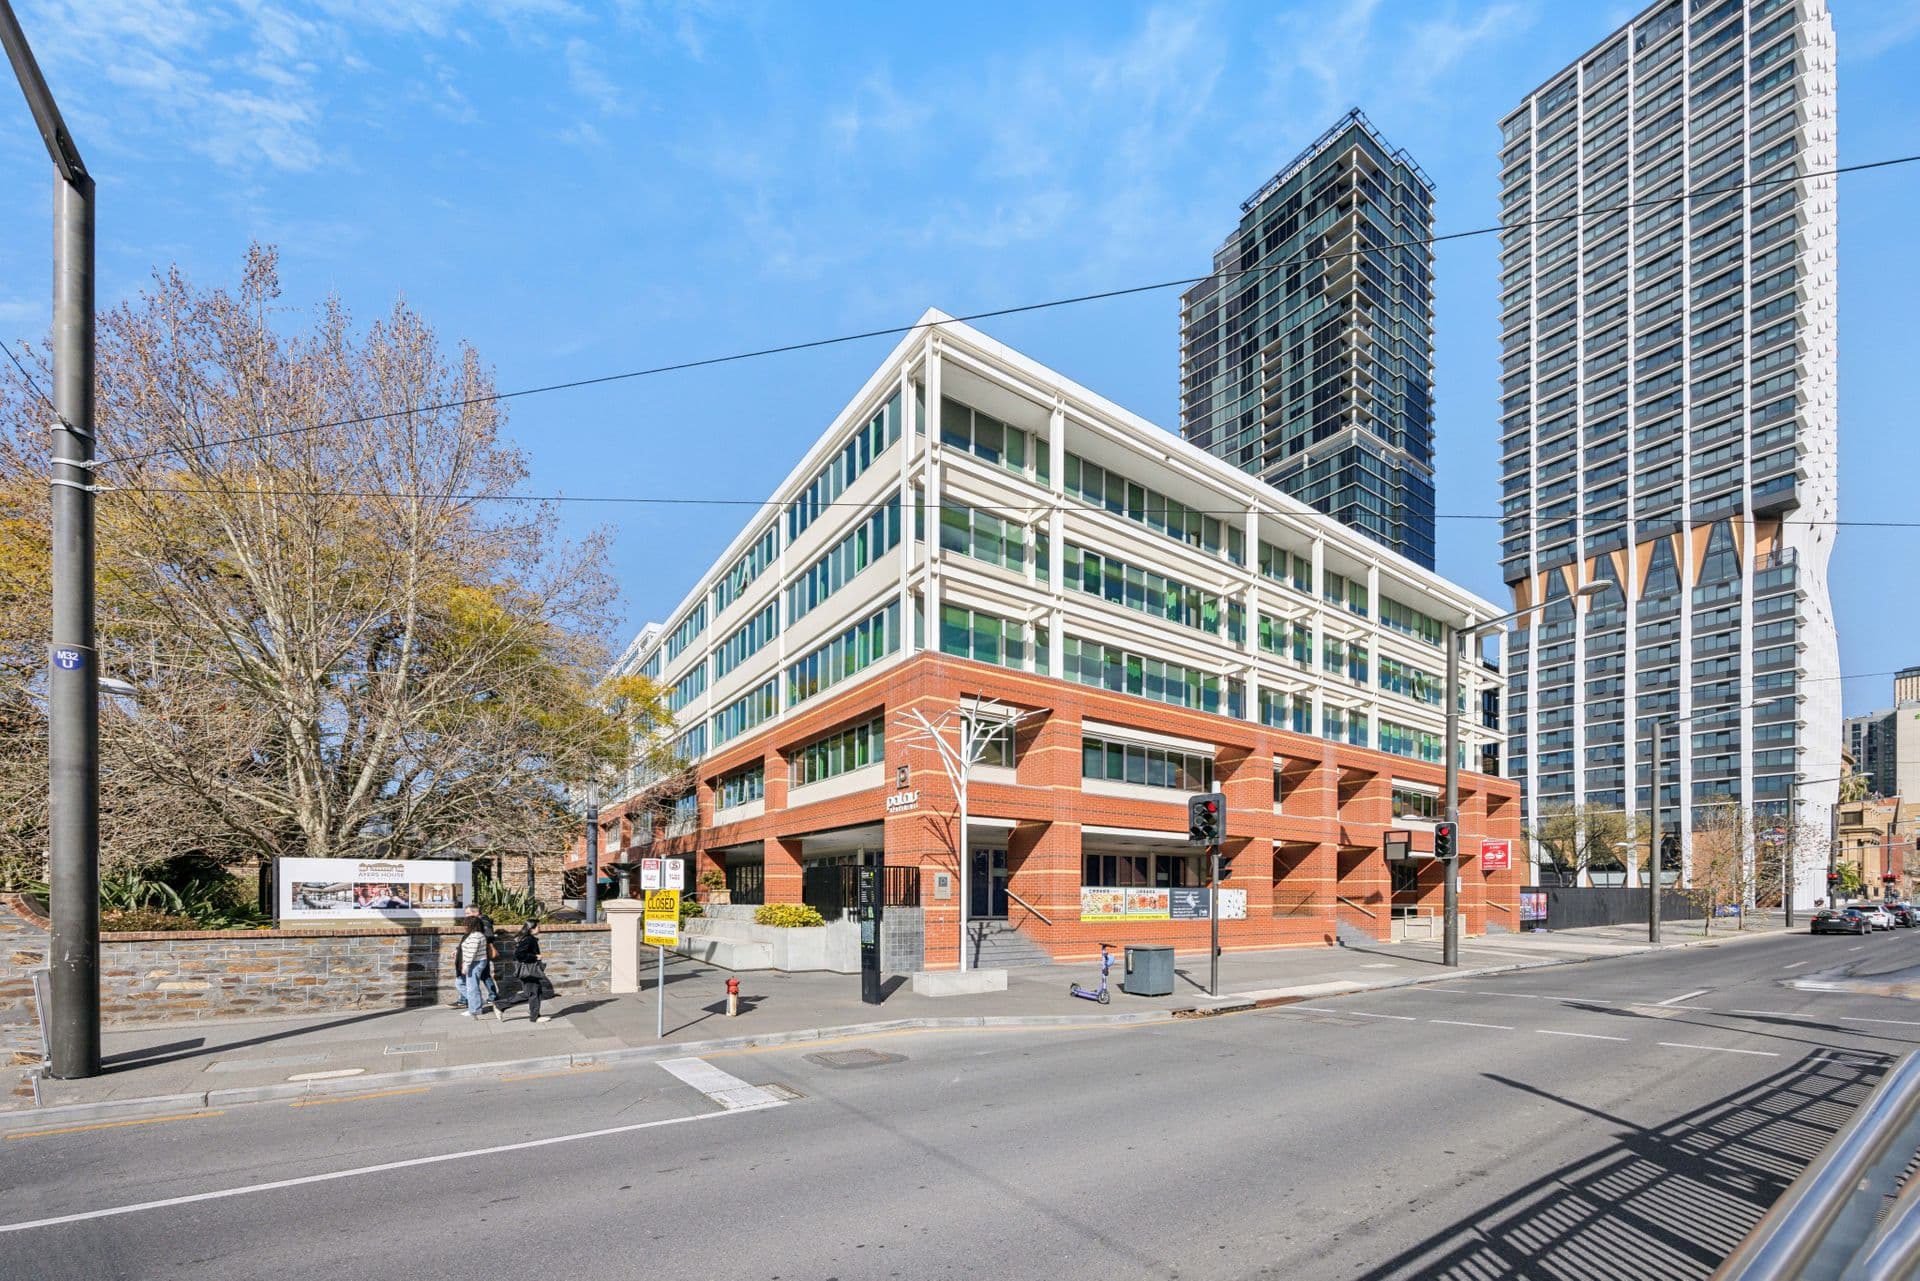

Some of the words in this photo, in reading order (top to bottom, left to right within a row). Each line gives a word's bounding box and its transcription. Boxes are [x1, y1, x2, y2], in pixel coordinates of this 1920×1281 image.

[57, 651, 79, 661] M32
[62, 660, 73, 669] U
[648, 897, 675, 910] CLOSED
